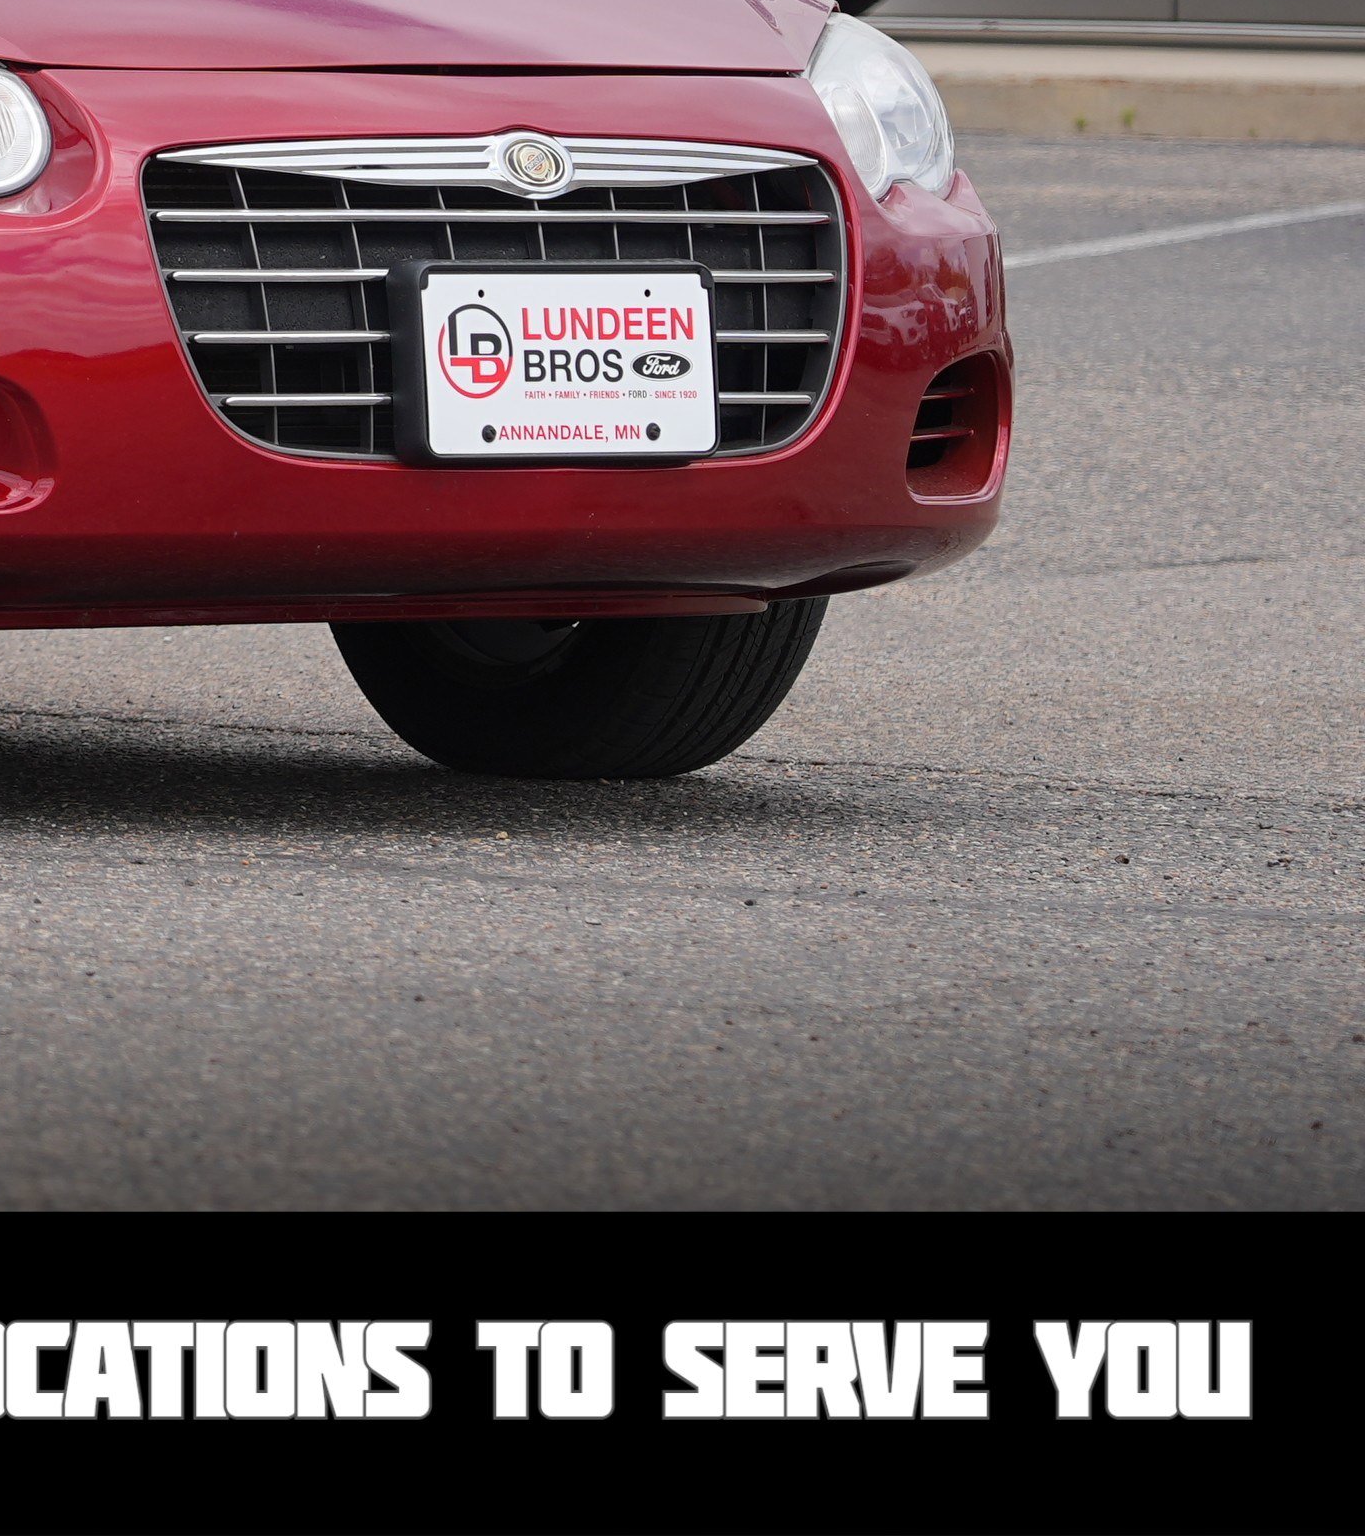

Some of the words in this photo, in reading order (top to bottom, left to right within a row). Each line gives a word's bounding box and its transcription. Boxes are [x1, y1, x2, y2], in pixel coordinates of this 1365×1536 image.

[521, 307, 694, 340] LUNDEEN
[523, 348, 624, 383] BROS
[642, 354, 681, 377] Ford
[524, 390, 546, 399] FAITH
[554, 390, 581, 399] FAMILY
[589, 390, 620, 399] FRIENDS
[628, 390, 647, 399] FORD
[654, 390, 677, 399] SINCE
[679, 390, 697, 399] 1920
[498, 425, 609, 443] ANNANDALE,
[614, 424, 641, 440] MN
